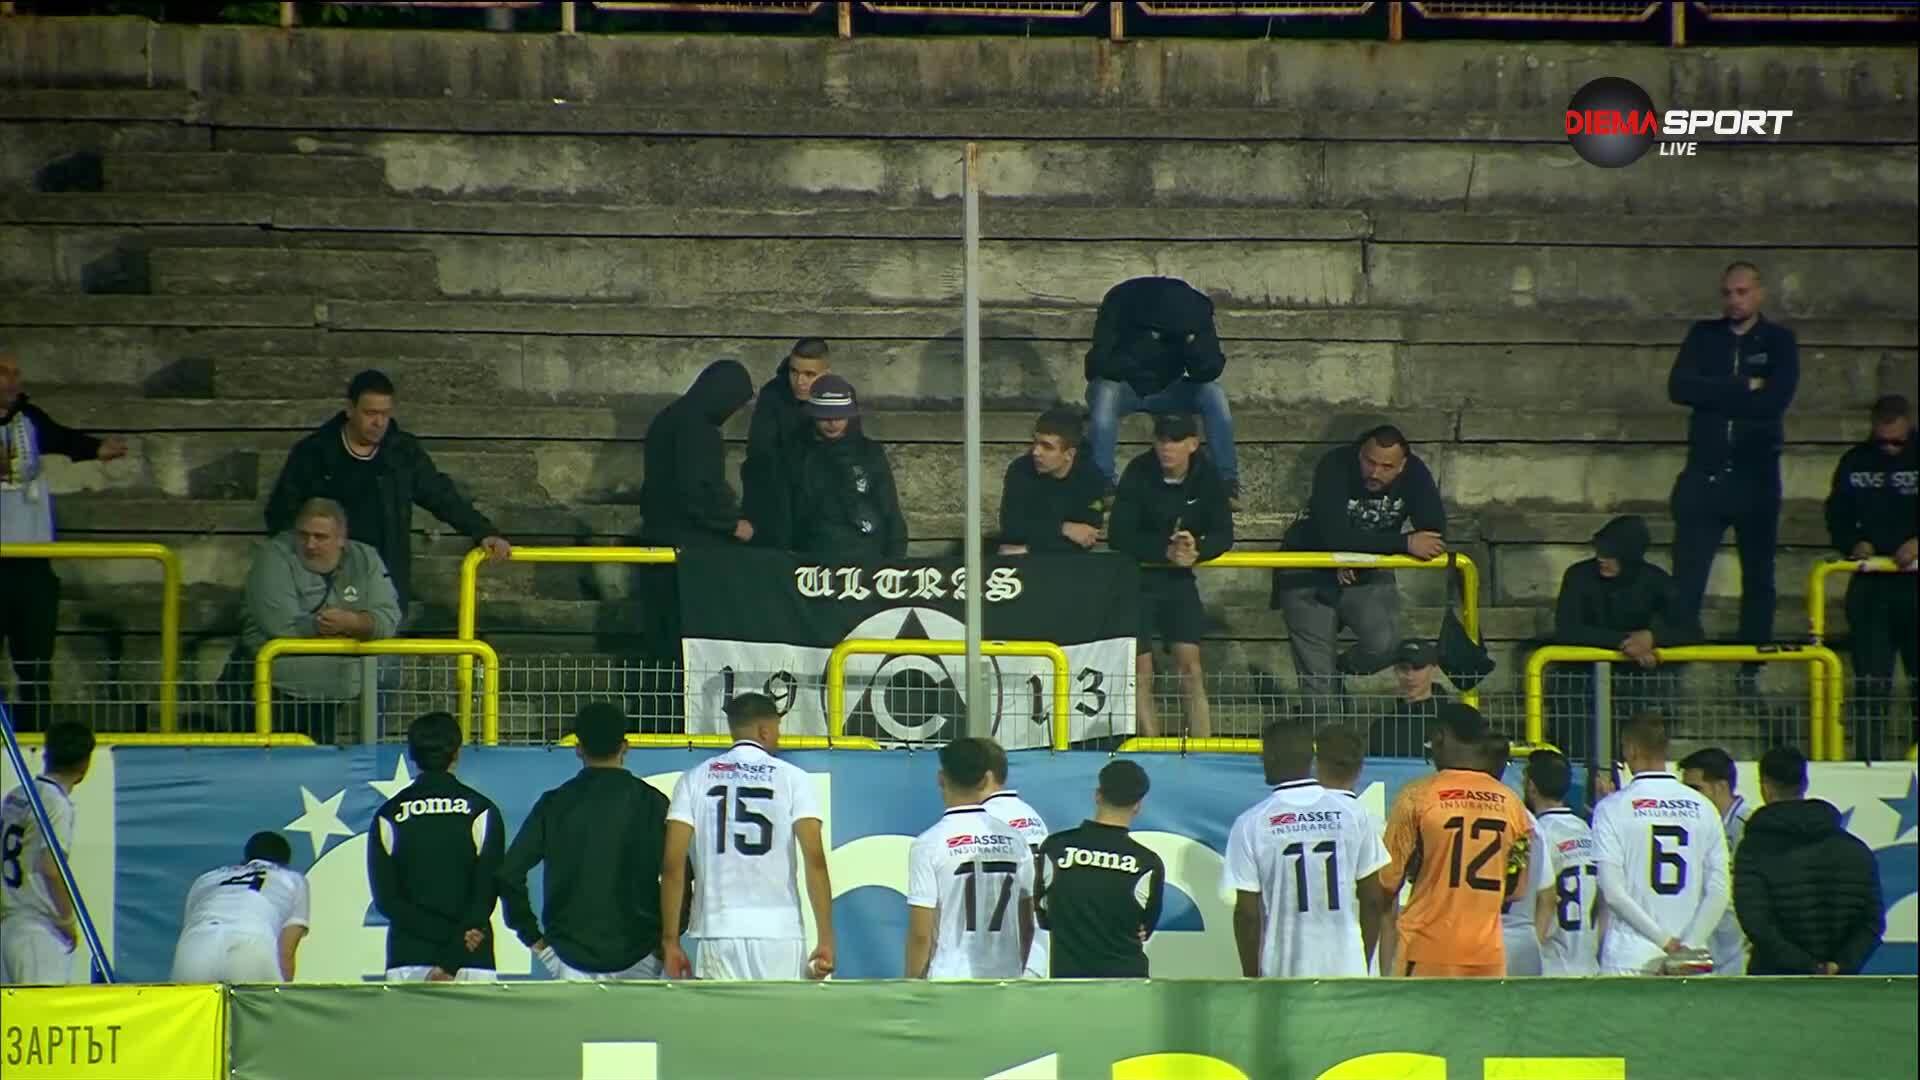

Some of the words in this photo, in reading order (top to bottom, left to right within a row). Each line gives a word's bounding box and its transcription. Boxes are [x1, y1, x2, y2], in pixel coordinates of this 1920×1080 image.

[735, 762, 776, 774] ASSET
[1467, 790, 1506, 803] ASSET
[1659, 799, 1700, 810] ASSET
[706, 784, 775, 856] 15
[1297, 811, 1342, 822] ASSET
[973, 834, 1013, 846] ASSET
[1444, 815, 1506, 891] 12
[1057, 846, 1140, 874] Joma
[1282, 840, 1340, 912] 11
[1650, 824, 1690, 895] 6
[218, 870, 267, 893] 4
[953, 860, 1018, 932] 17
[1556, 863, 1600, 931] 87
[0, 1025, 122, 1065] ЗАРТЪТ
